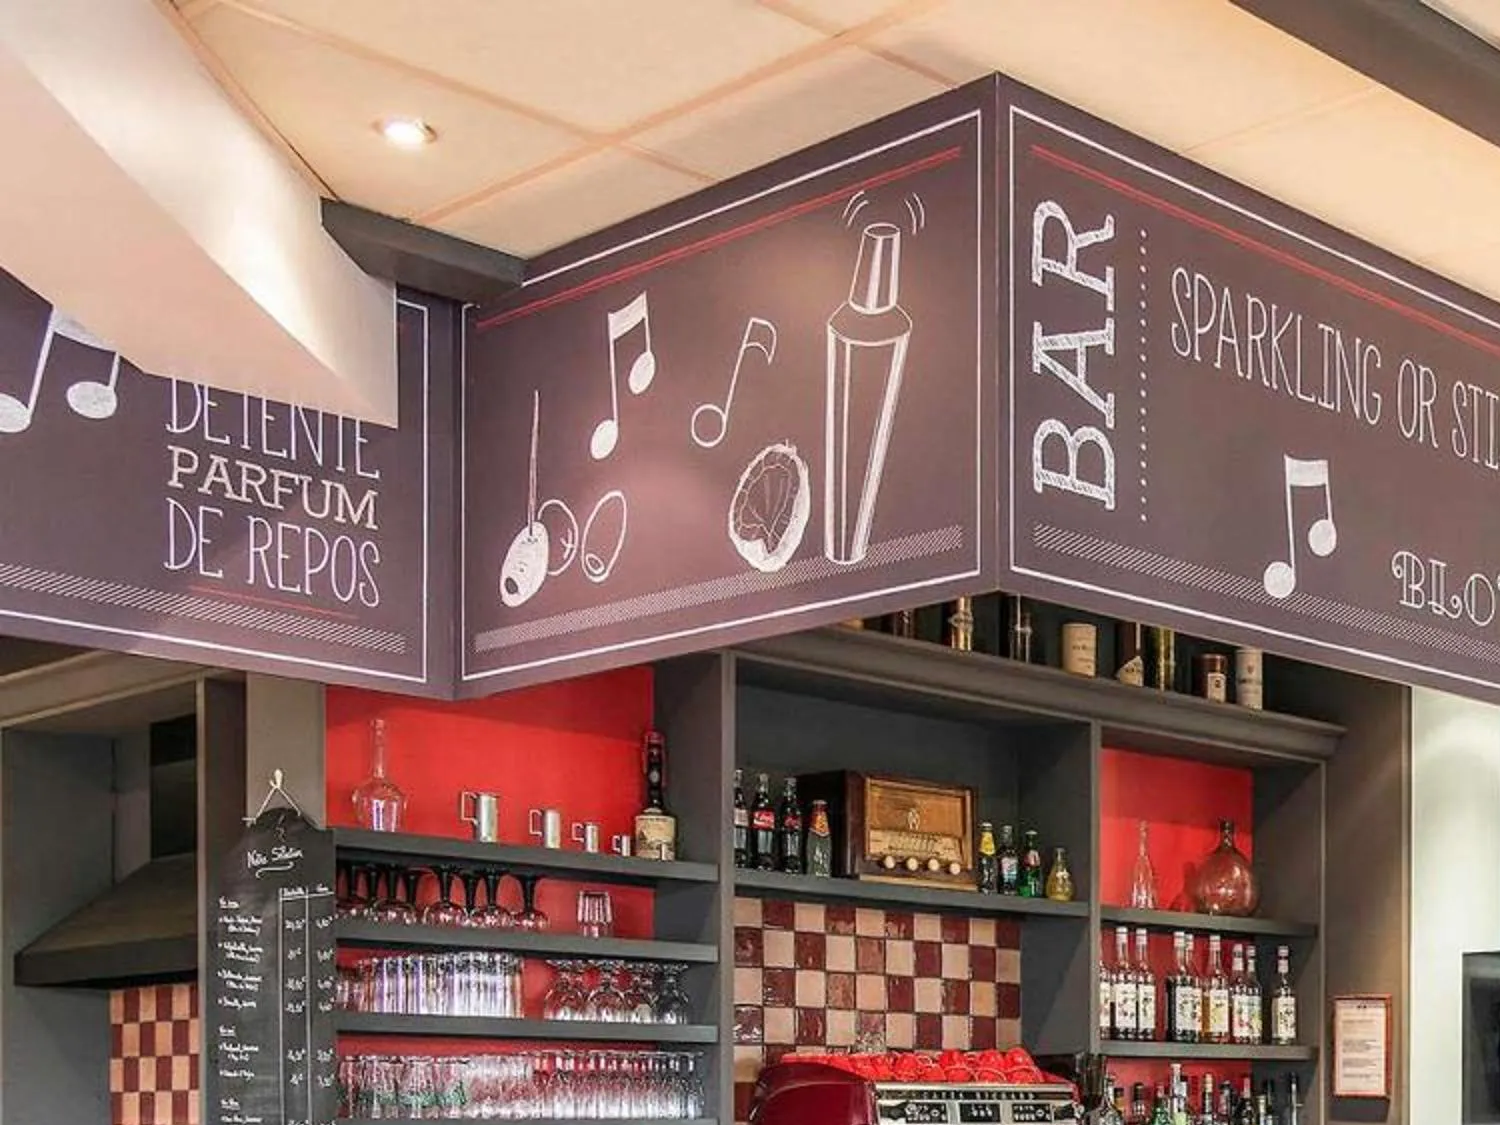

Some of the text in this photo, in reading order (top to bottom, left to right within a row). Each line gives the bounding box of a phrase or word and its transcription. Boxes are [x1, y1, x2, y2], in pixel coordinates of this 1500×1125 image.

[1032, 200, 1115, 511] BAR
[1170, 266, 1381, 426] SPARKLING
[1397, 358, 1439, 449] OR
[164, 498, 380, 608] DE REPOS
[167, 445, 379, 530] PARFUM
